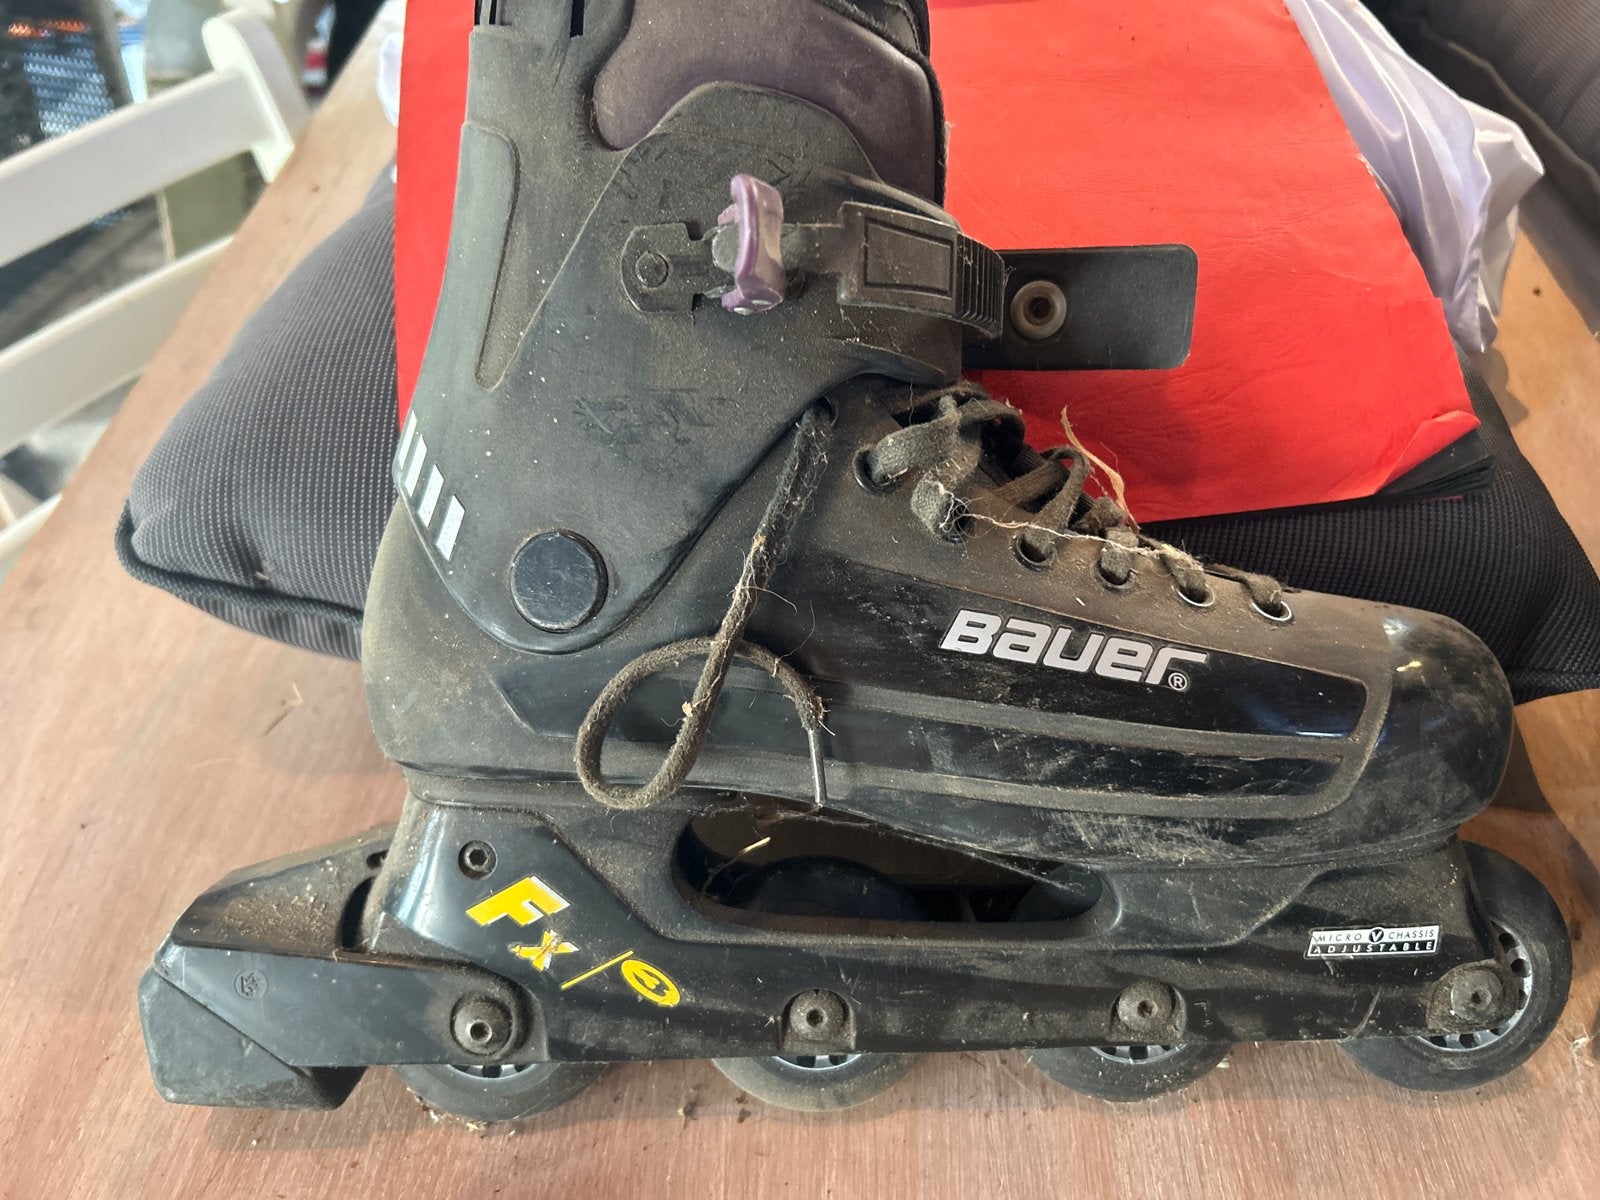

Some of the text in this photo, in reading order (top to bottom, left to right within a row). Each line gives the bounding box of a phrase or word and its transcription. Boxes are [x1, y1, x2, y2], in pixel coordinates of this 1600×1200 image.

[1317, 932, 1363, 943] MICRO
[1388, 929, 1435, 940] CHASSIS
[1313, 941, 1433, 954] ADJUSTABLE
